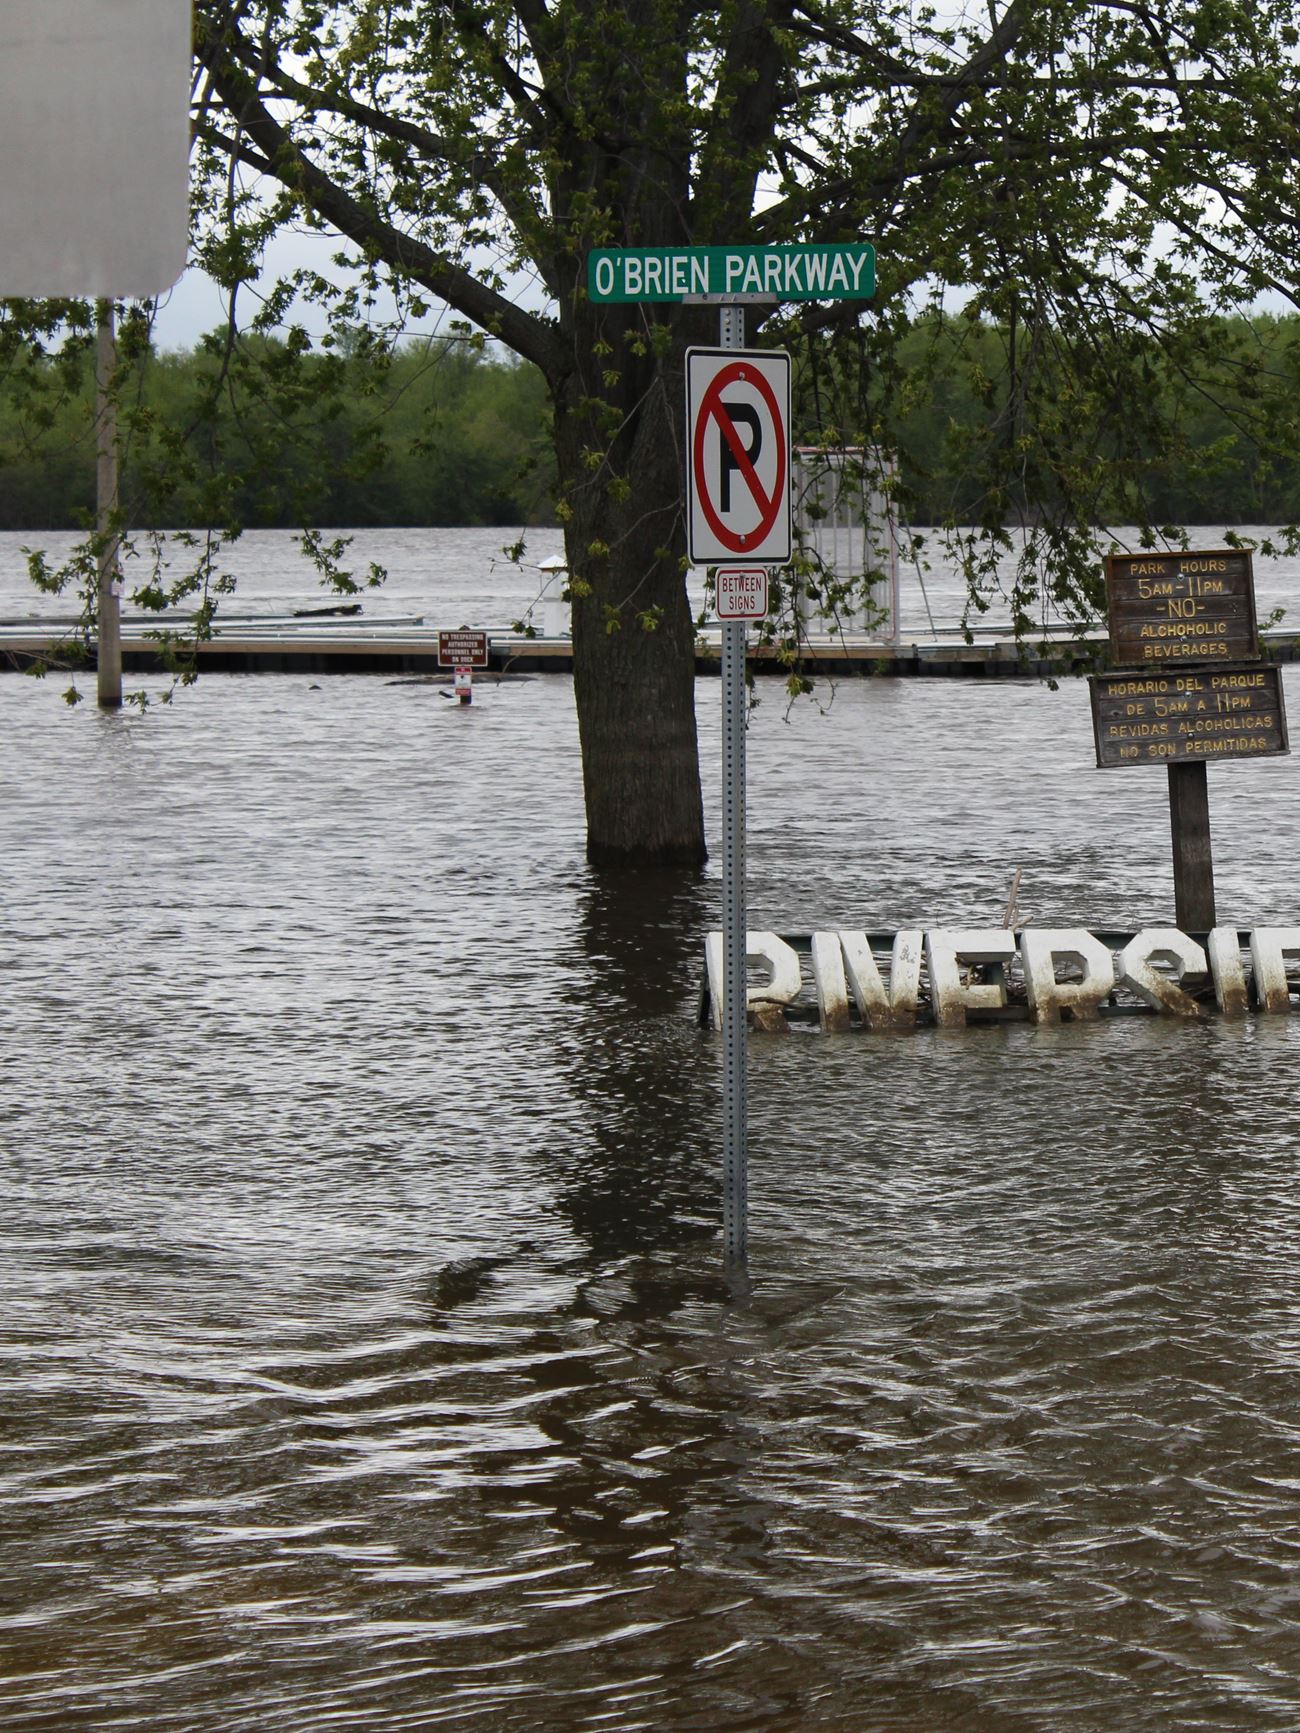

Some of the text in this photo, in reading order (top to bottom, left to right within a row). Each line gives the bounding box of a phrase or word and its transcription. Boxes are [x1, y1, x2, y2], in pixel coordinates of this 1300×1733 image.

[595, 252, 867, 295] O'BRIEN PARKWAY
[1130, 560, 1226, 575] PARK HOURS
[722, 577, 761, 592] BETWEEN
[729, 596, 755, 610] SIGNS
[1140, 622, 1226, 637] ALCHOHOLIC
[1144, 643, 1227, 658] BEVERAGES
[1108, 674, 1264, 695] HORARIO DEL PARQUE
[1126, 704, 1145, 715] DE
[1197, 700, 1206, 711] A
[1178, 716, 1273, 733] ALCOHOLICAS
[1120, 738, 1267, 758] NO SON PERMITIDAS
